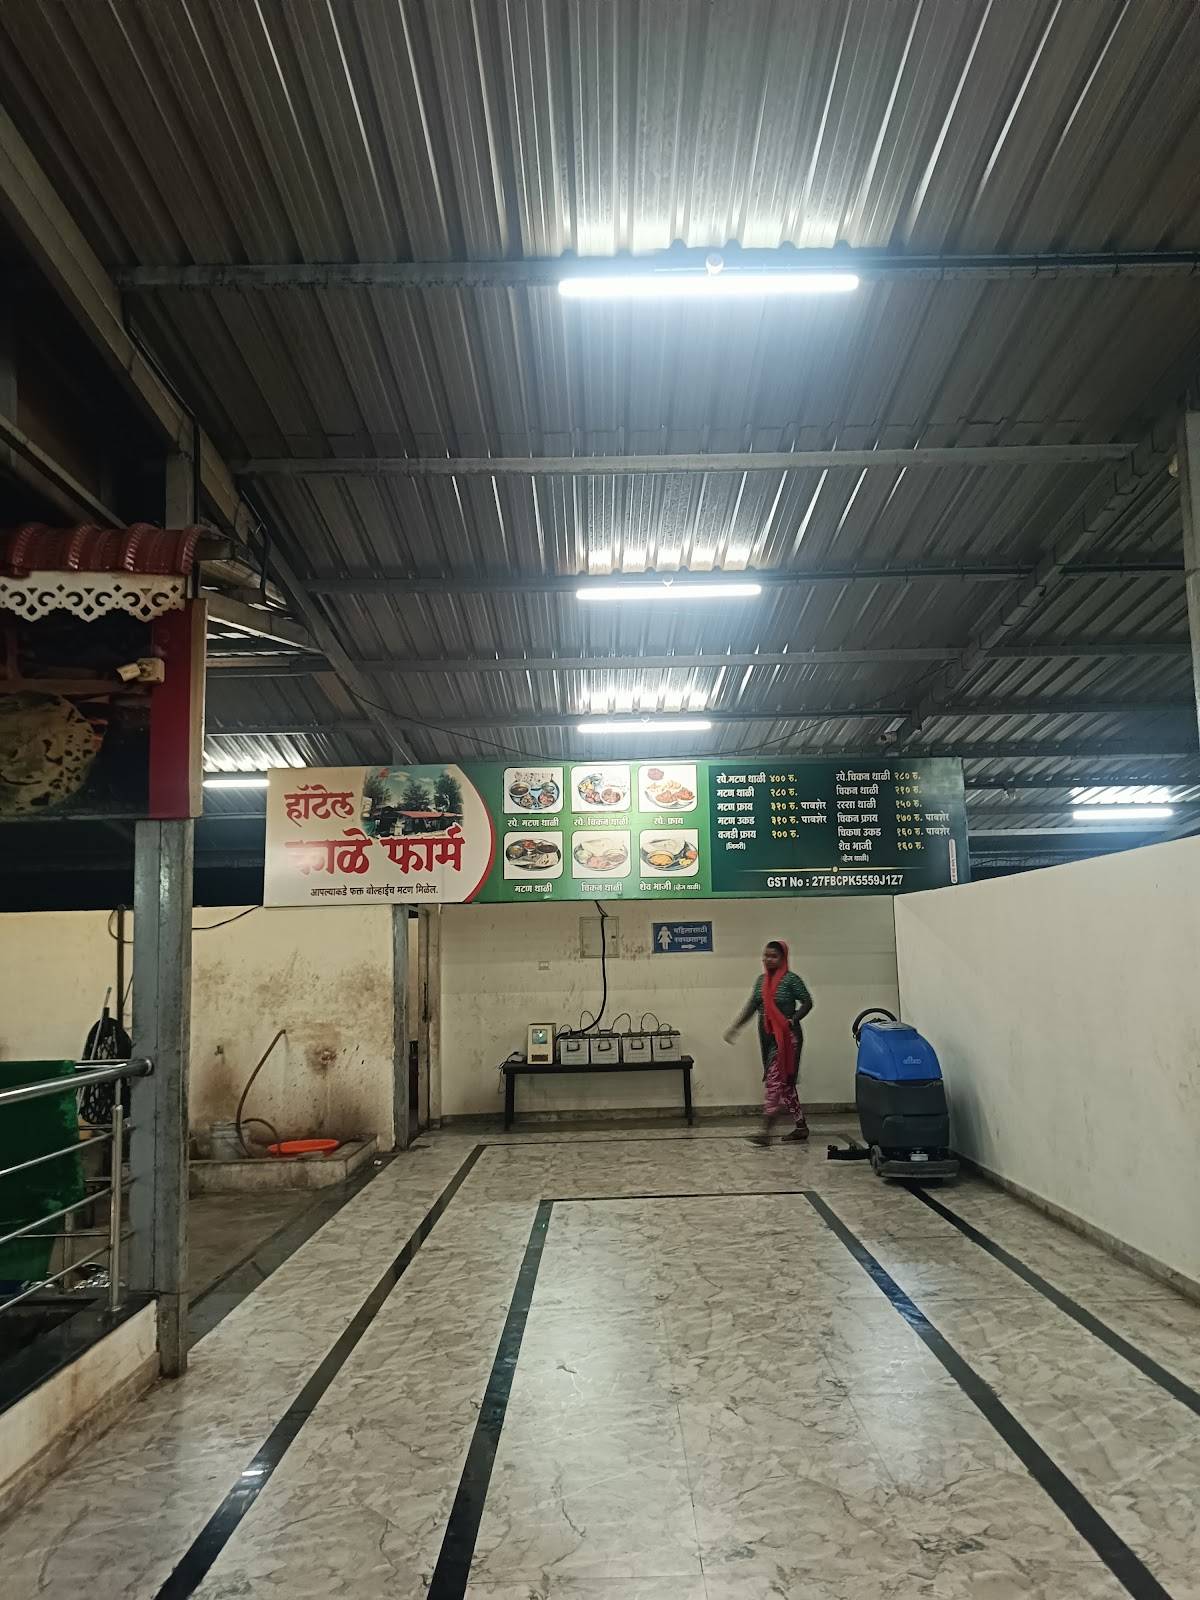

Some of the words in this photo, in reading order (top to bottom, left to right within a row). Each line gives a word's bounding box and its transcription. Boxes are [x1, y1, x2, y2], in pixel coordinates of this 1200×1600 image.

[748, 772, 766, 783] थाळी
[872, 770, 890, 780] थाळी
[894, 772, 910, 780] २८०
[716, 789, 734, 798] मटण
[736, 786, 754, 798] थाळी
[770, 788, 786, 796] २८०
[836, 784, 858, 795] चिकन
[860, 784, 879, 795] थाळी
[284, 784, 354, 827] हॉटेल
[717, 802, 735, 811] मटण
[736, 802, 753, 812] फ्राय
[800, 798, 826, 810] पावशेर
[836, 800, 856, 810] रस्सा
[858, 798, 876, 808] थाळी
[895, 800, 911, 808] १५०
[540, 818, 559, 826] थाळी
[609, 815, 628, 826] थाळी
[717, 816, 736, 825] मटण
[737, 816, 755, 824] उकड
[800, 812, 827, 824] पावशेर
[837, 812, 860, 823] चिकन
[860, 814, 878, 824] फ्राय
[896, 814, 912, 822] १७०
[924, 810, 950, 822] पावशेर
[740, 830, 757, 840] फ्राय
[772, 830, 788, 838] २००
[838, 826, 861, 837] चिकण
[862, 828, 882, 836] उकड
[896, 828, 912, 837] १६०
[926, 824, 950, 836] पावशेर
[380, 823, 466, 874] फार्म
[838, 840, 850, 851] शेव
[852, 839, 872, 850] भाजी
[640, 882, 652, 891] शेव
[653, 880, 672, 890] भाजी
[767, 876, 788, 888] GST
[790, 876, 804, 887] No
[812, 874, 904, 887] 27FBCPK5559J1Z7
[350, 886, 364, 896] फक्त
[396, 886, 413, 894] मटण
[514, 885, 532, 893] मटण
[534, 882, 552, 893] थाळी
[604, 882, 622, 892] थाळी
